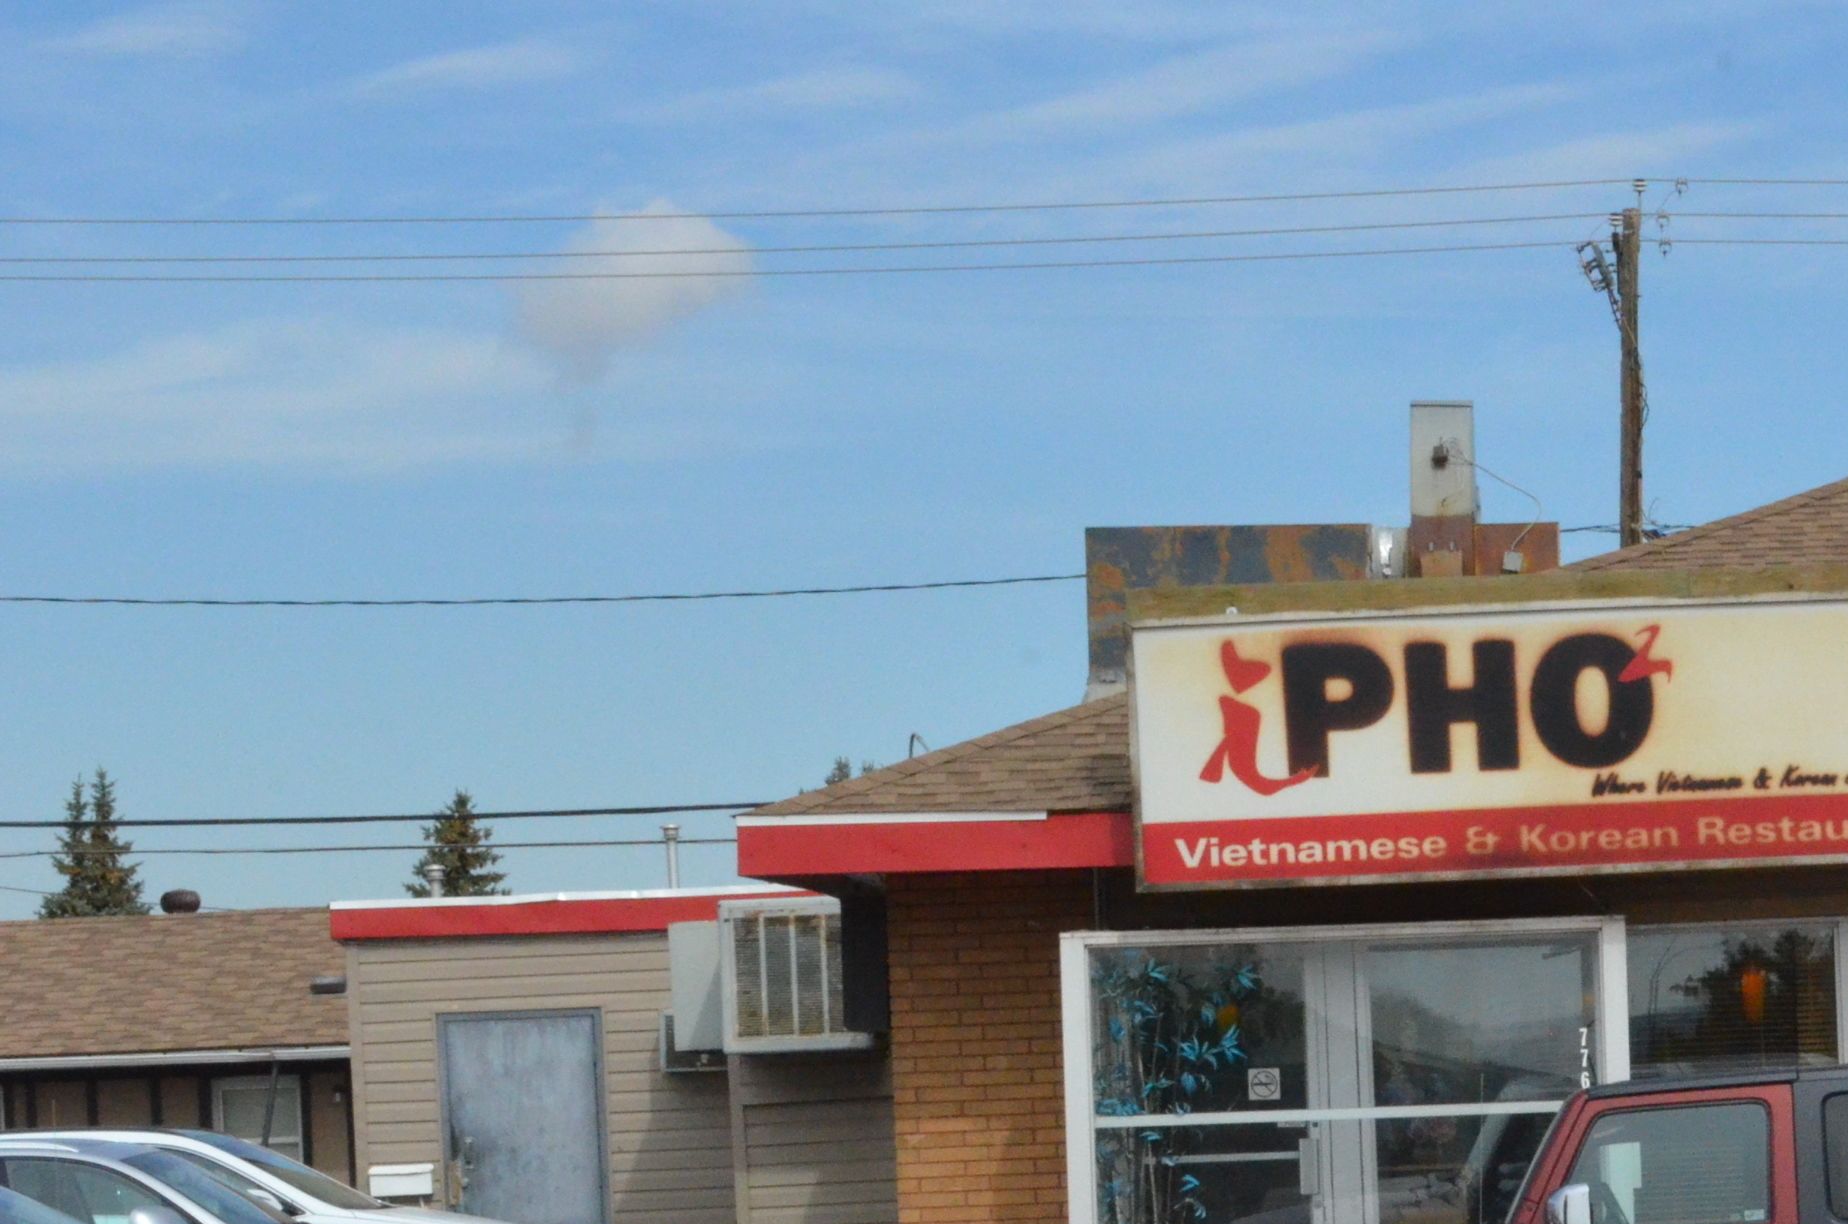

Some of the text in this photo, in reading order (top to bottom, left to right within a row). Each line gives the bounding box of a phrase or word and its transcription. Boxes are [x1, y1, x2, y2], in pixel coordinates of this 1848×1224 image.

[1753, 767, 1772, 790] &
[1779, 764, 1838, 788] Korean
[1174, 836, 1448, 870] Vietnamese
[1465, 826, 1499, 855] &
[1519, 823, 1679, 855] Korean
